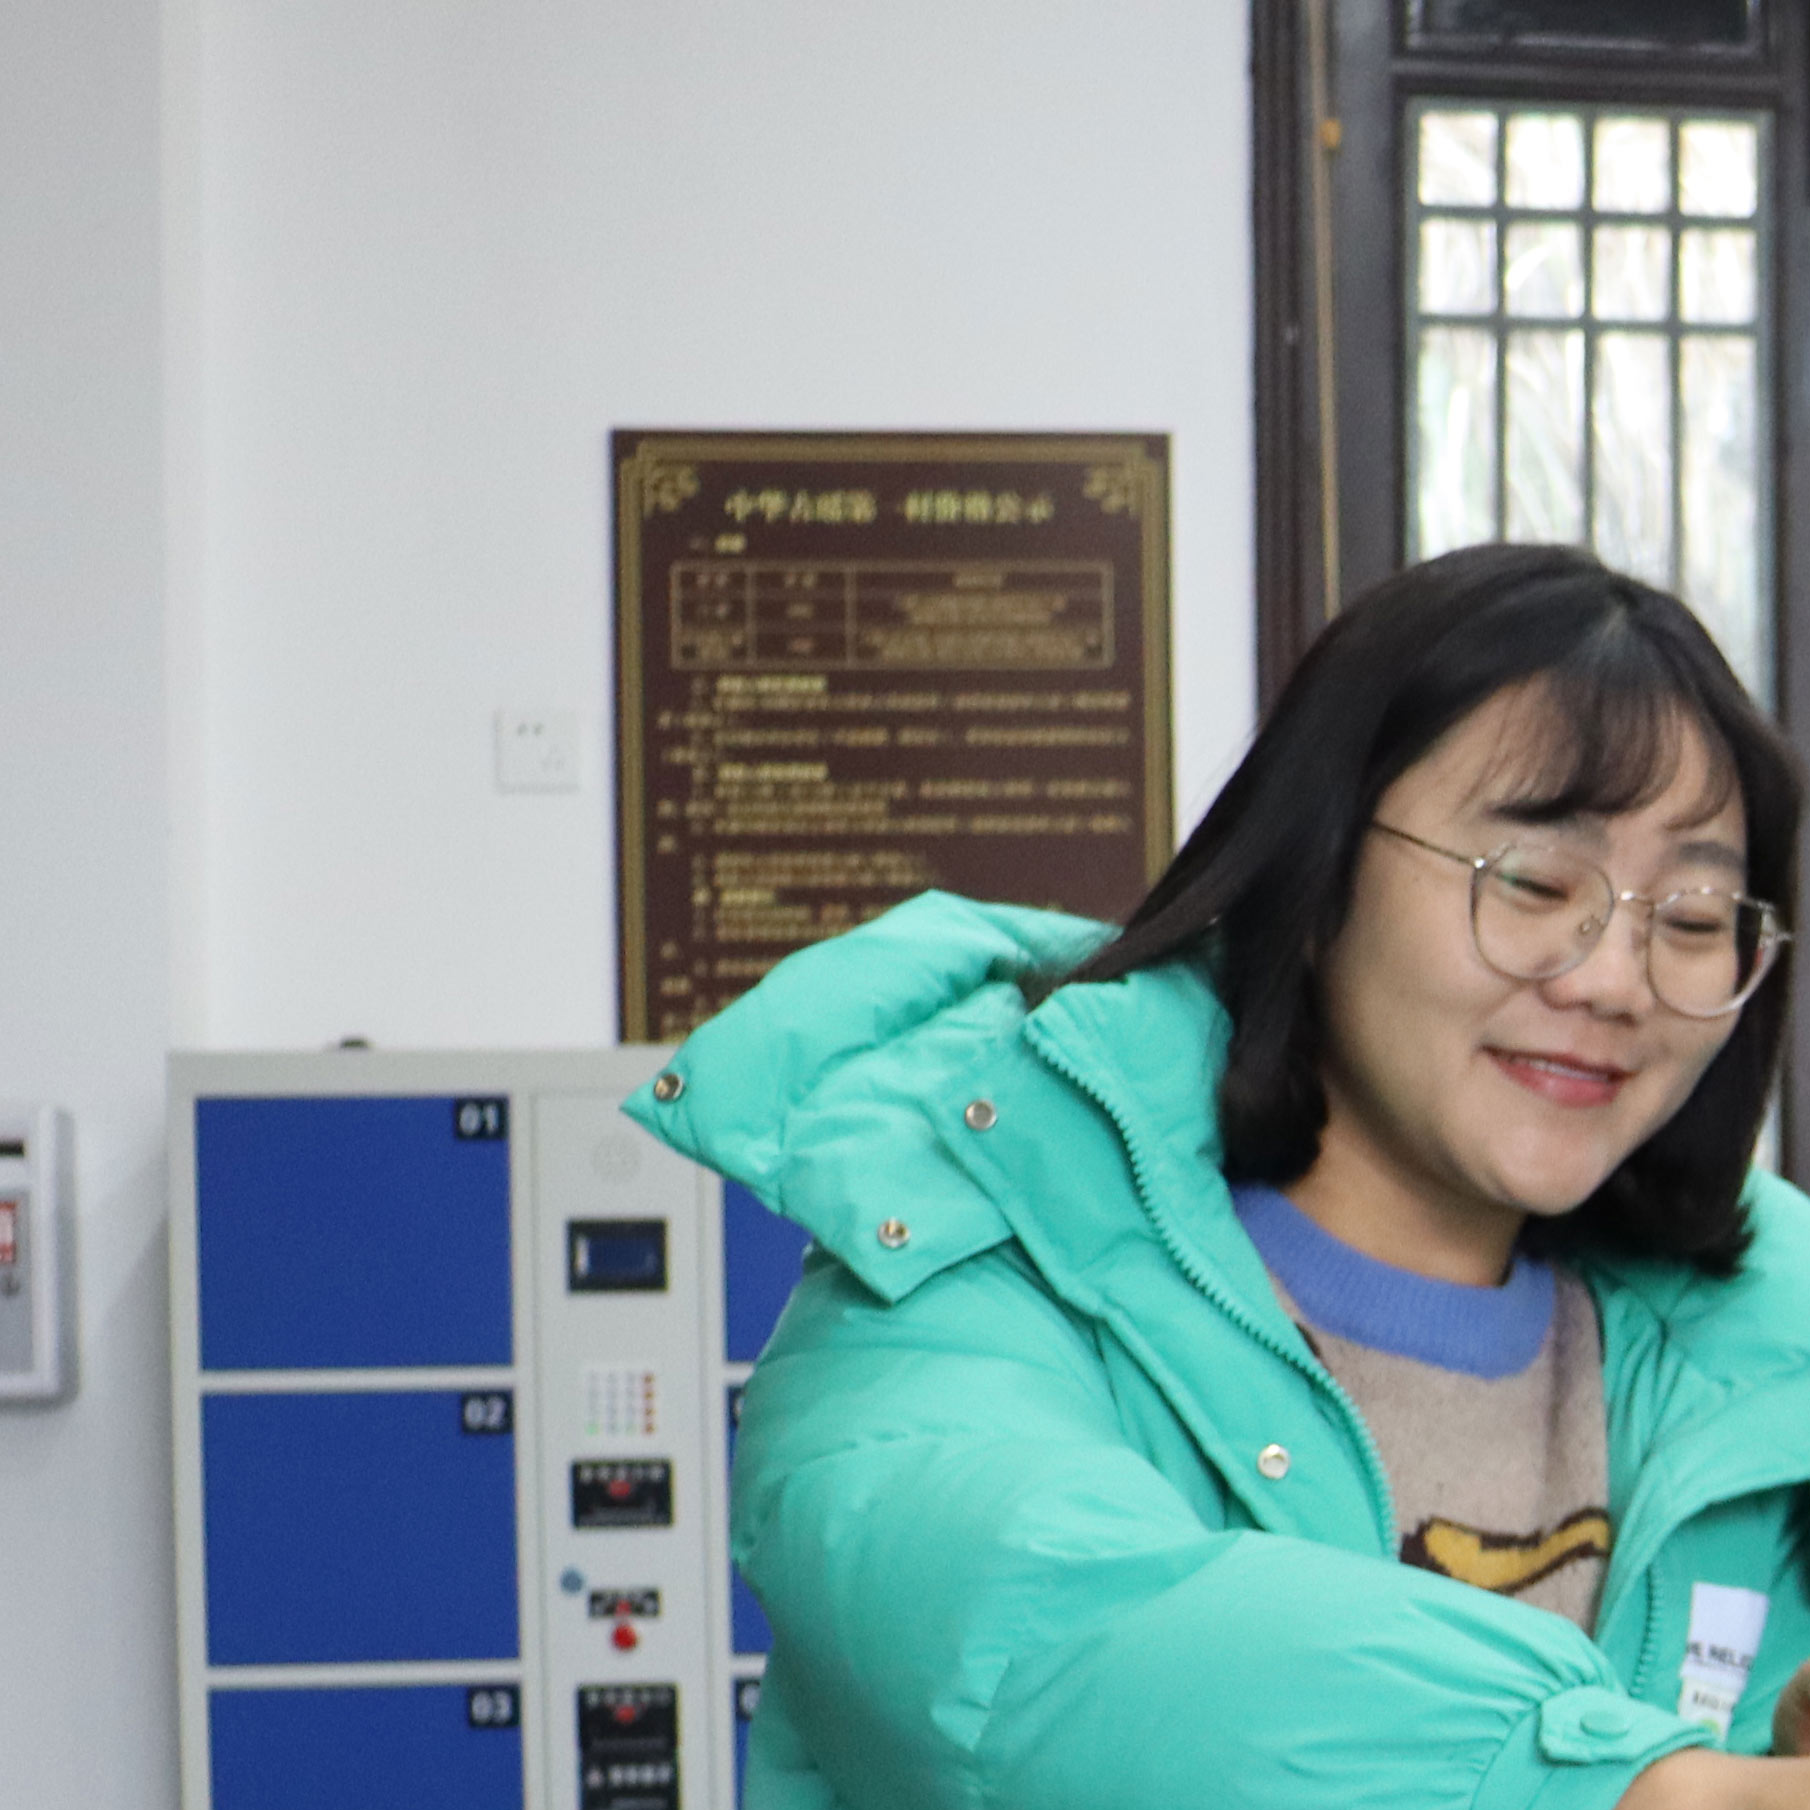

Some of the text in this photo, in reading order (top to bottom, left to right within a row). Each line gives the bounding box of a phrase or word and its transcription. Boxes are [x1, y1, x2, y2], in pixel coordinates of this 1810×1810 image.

[459, 1102, 500, 1135] 01
[463, 1397, 507, 1429] 02
[470, 1690, 513, 1724] 03
